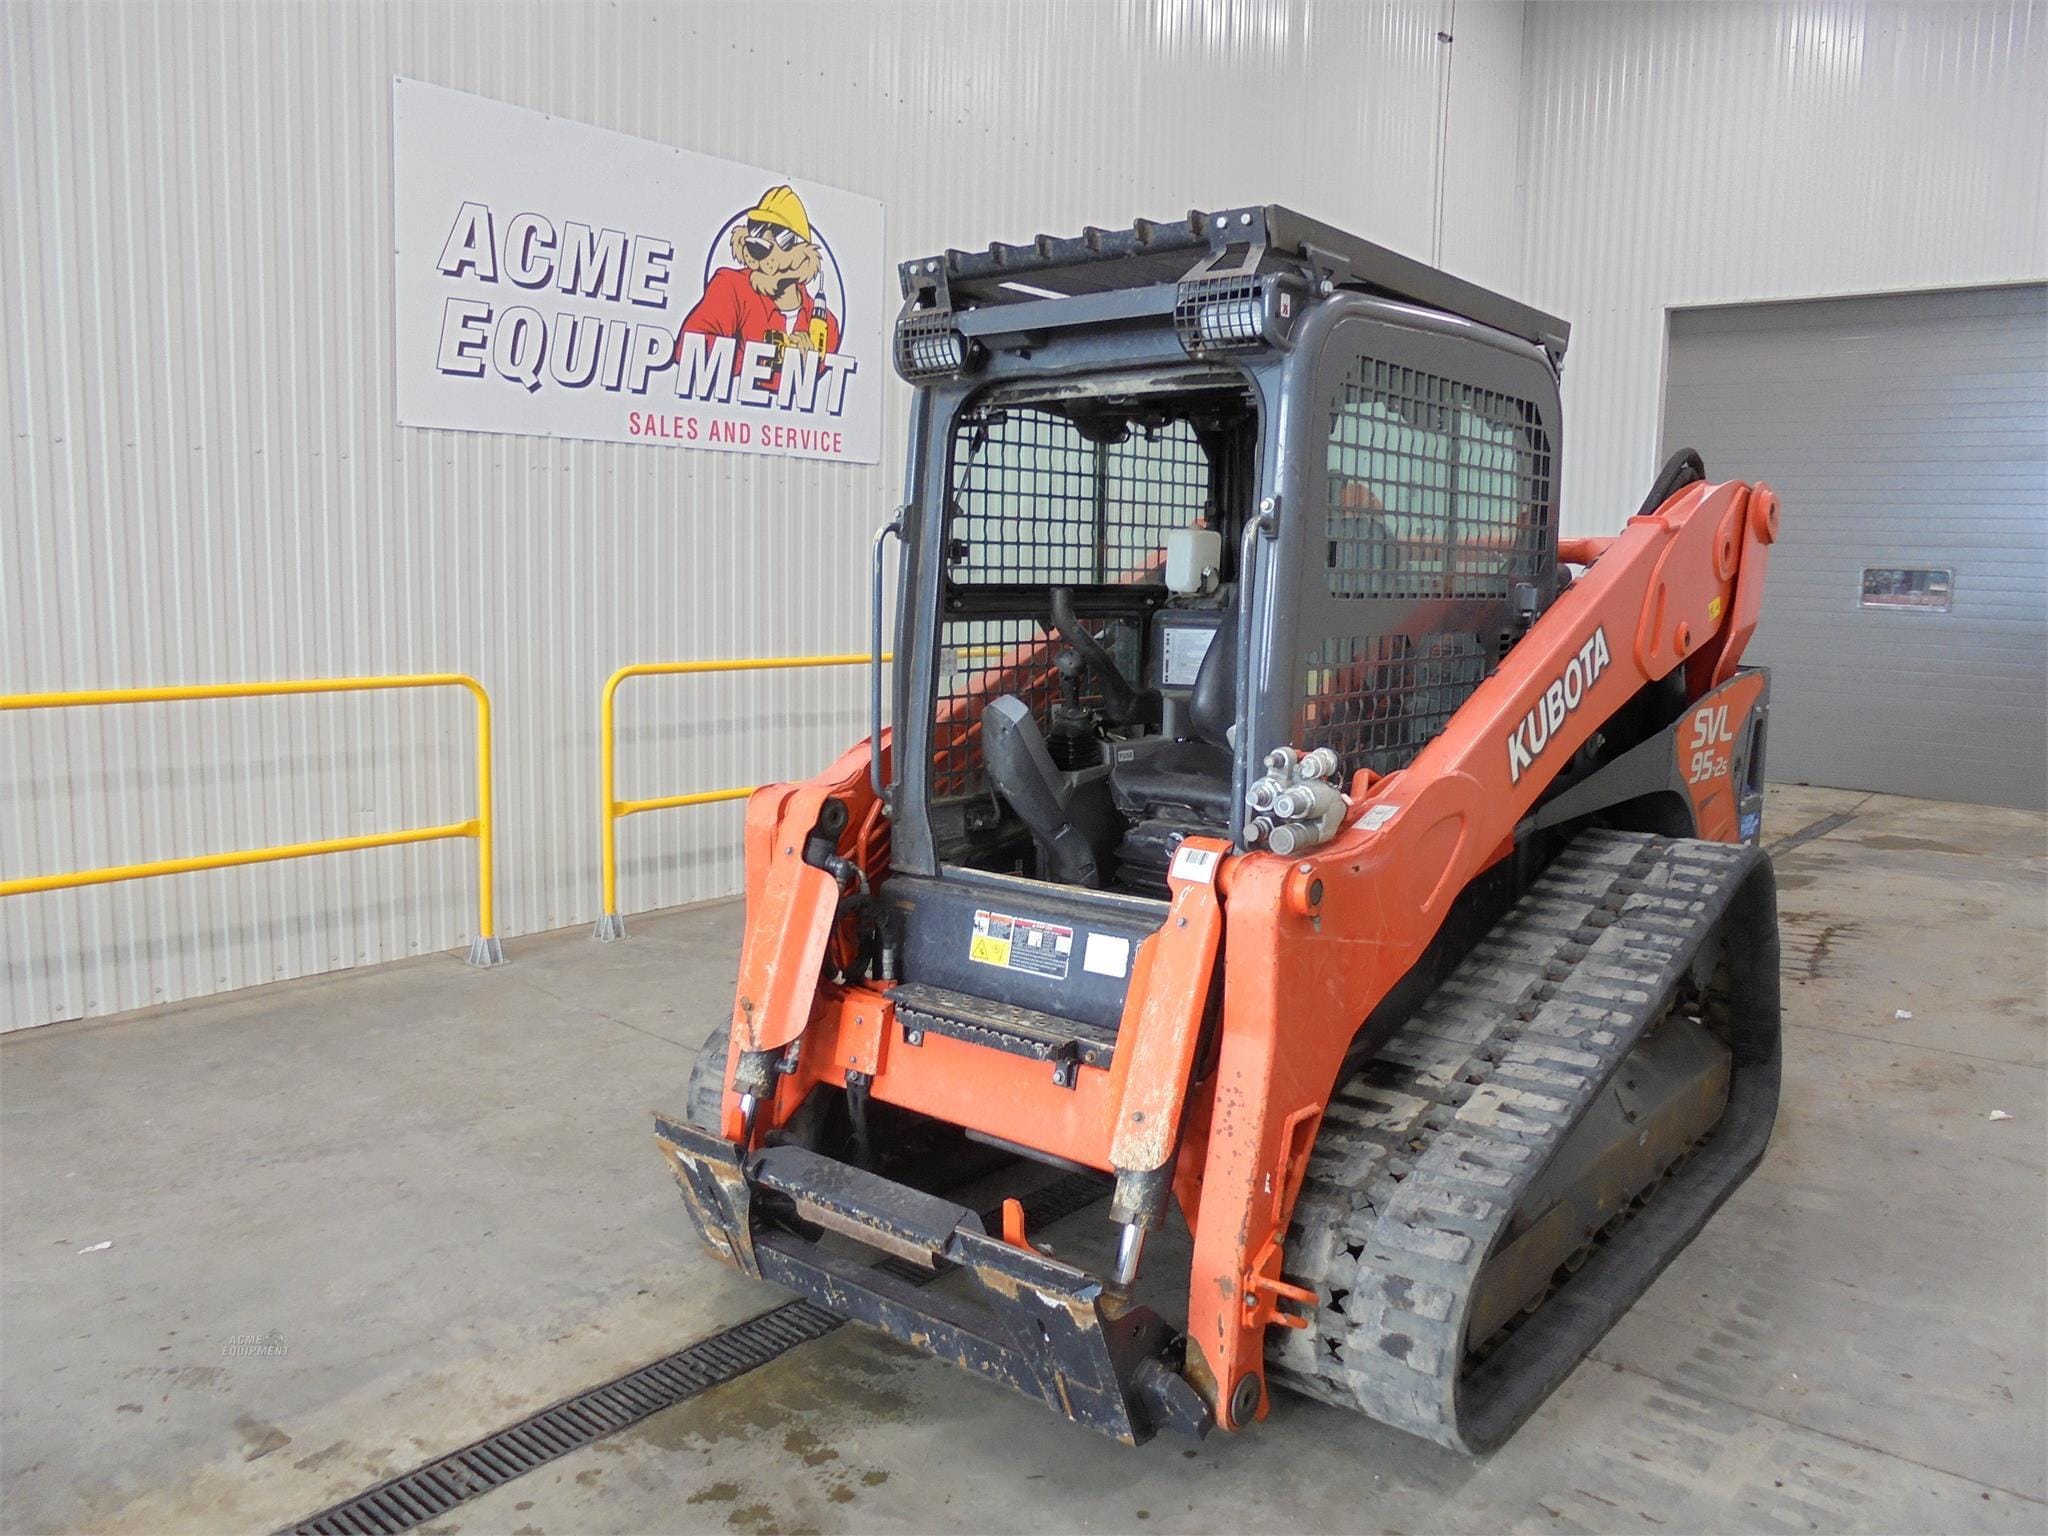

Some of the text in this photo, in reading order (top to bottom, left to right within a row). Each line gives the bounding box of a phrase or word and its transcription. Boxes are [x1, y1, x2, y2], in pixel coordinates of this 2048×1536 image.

[436, 201, 675, 309] ACME
[435, 297, 858, 418] EQUIPMENT
[628, 411, 843, 454] SALES AND SERVICE
[1508, 627, 1611, 783] KUBOTA
[1690, 705, 1733, 749] SVL
